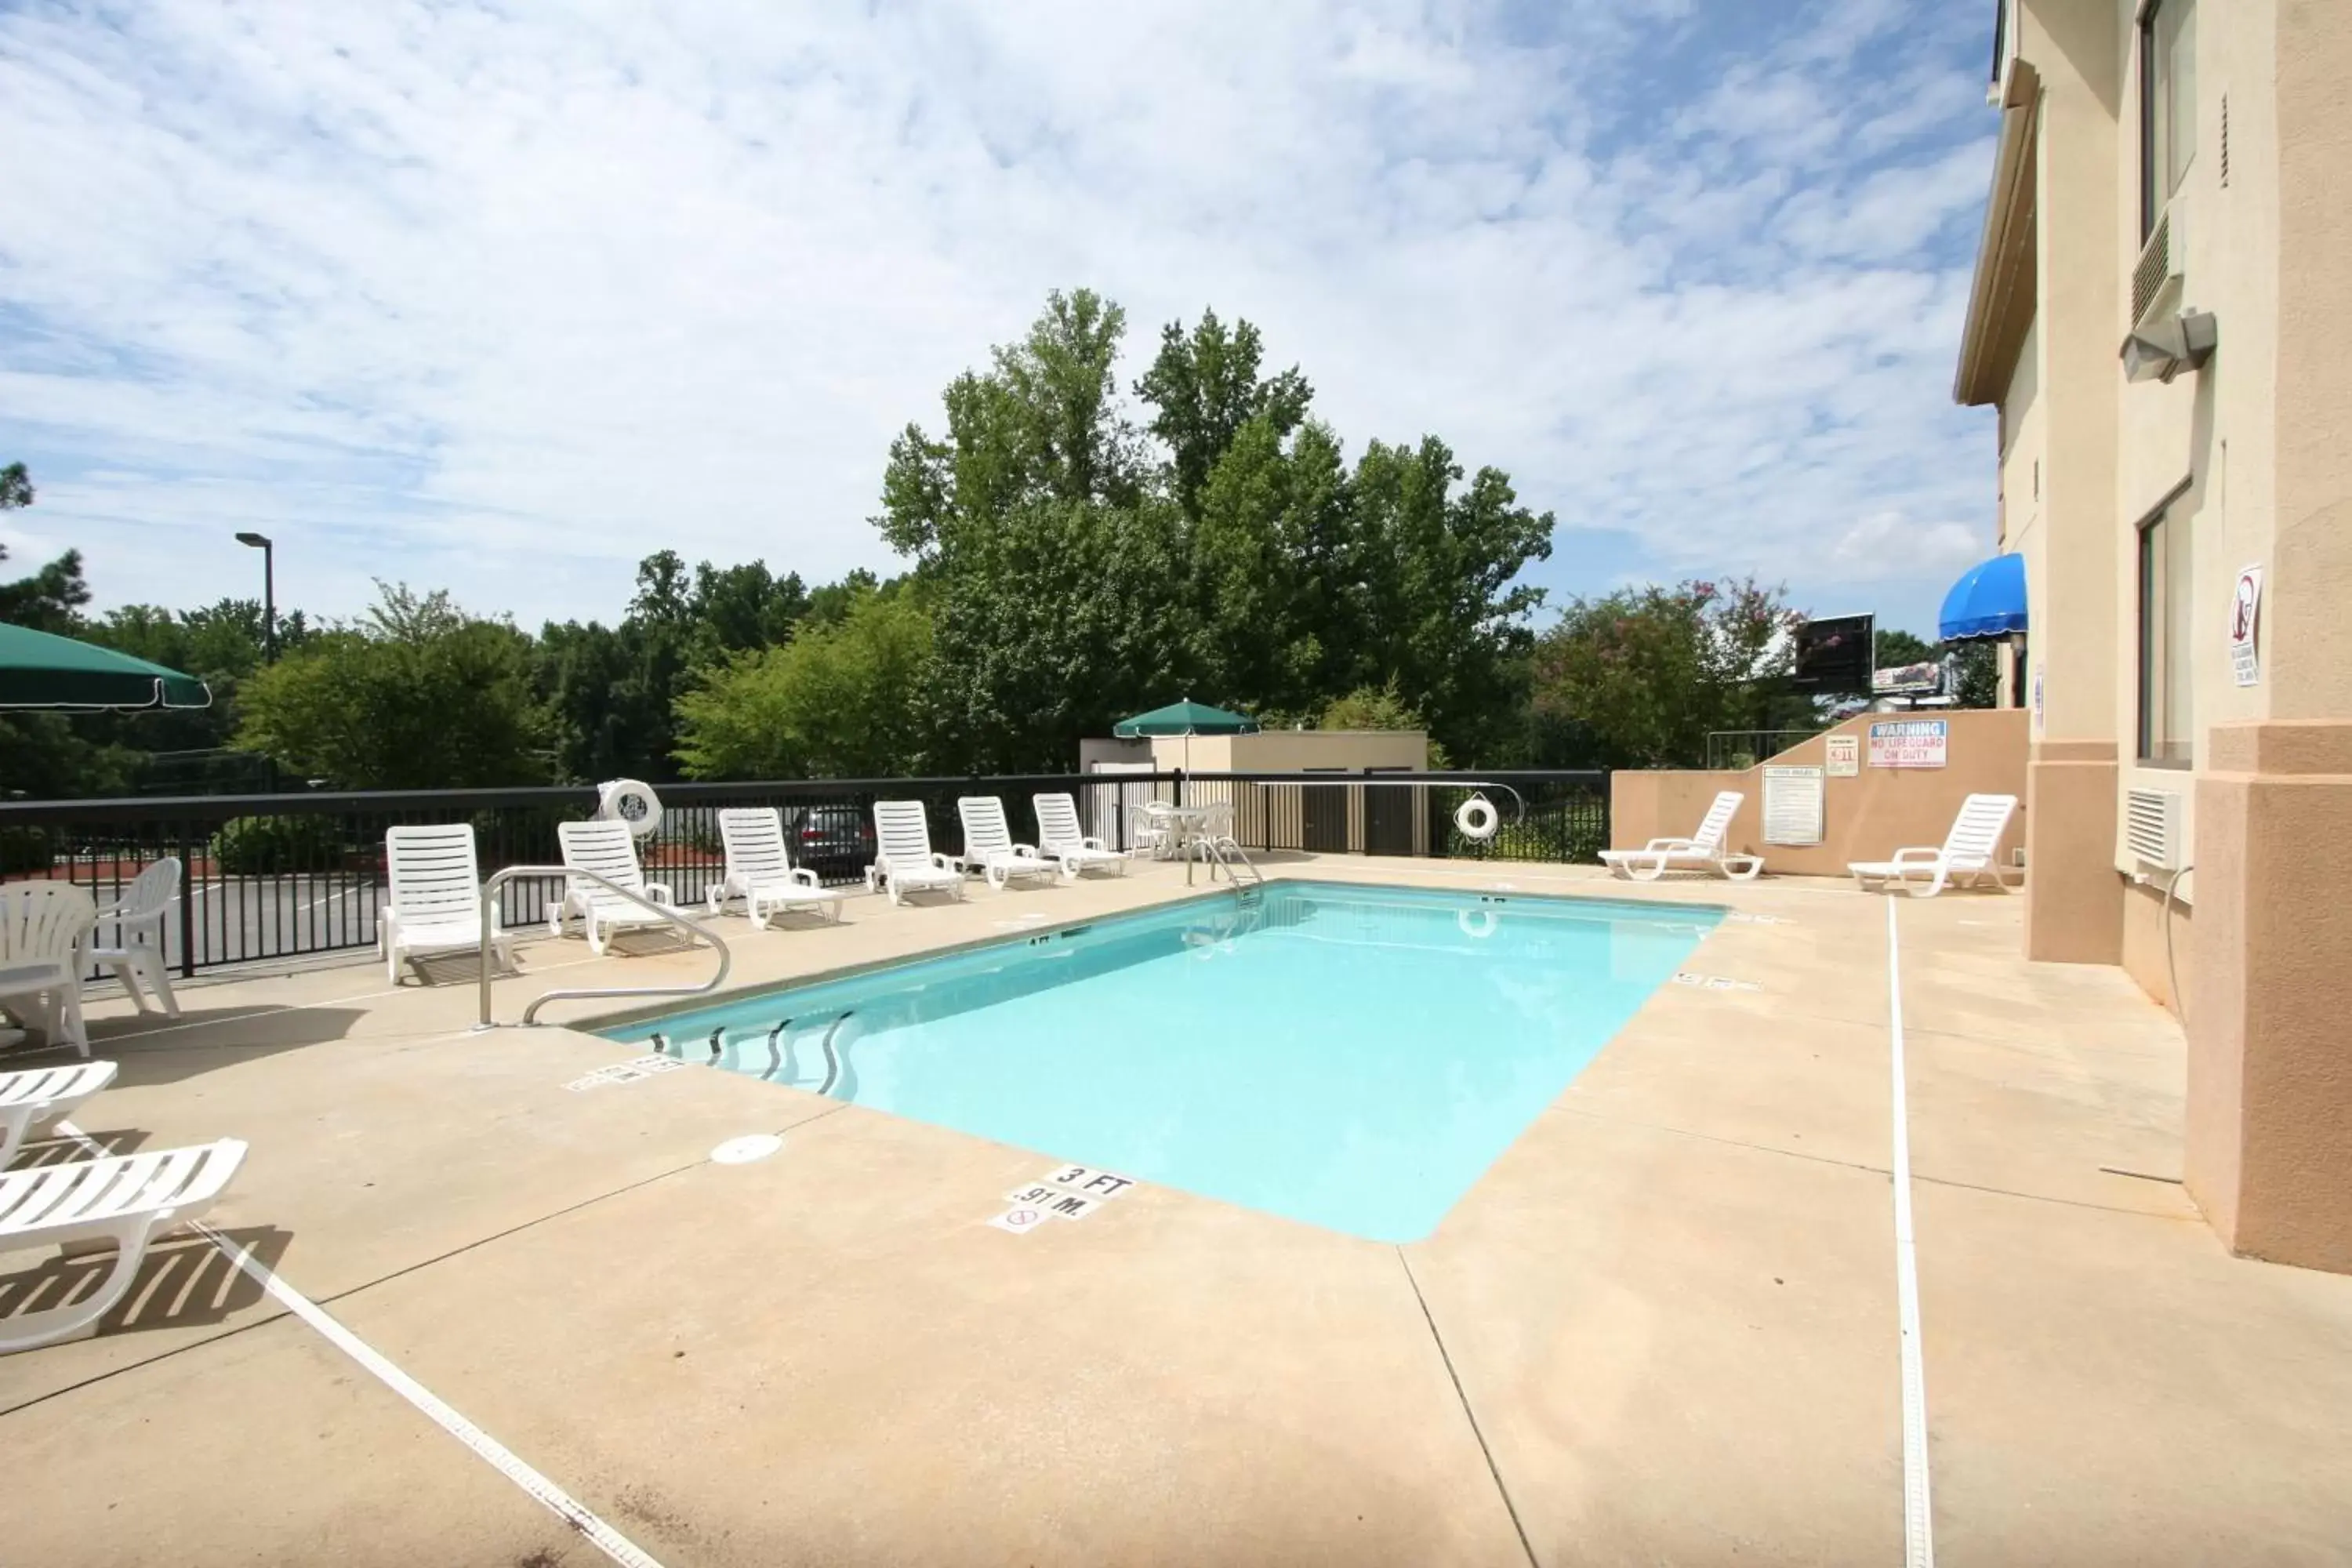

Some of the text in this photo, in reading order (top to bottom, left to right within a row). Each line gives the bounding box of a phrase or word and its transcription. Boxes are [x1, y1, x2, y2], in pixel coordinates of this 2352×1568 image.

[1877, 722, 1941, 736] WARNING
[1871, 737, 1944, 749] NO LIFEGUARD
[1884, 749, 1928, 760] ON DUTY
[1057, 1168, 1133, 1195] 3 FT
